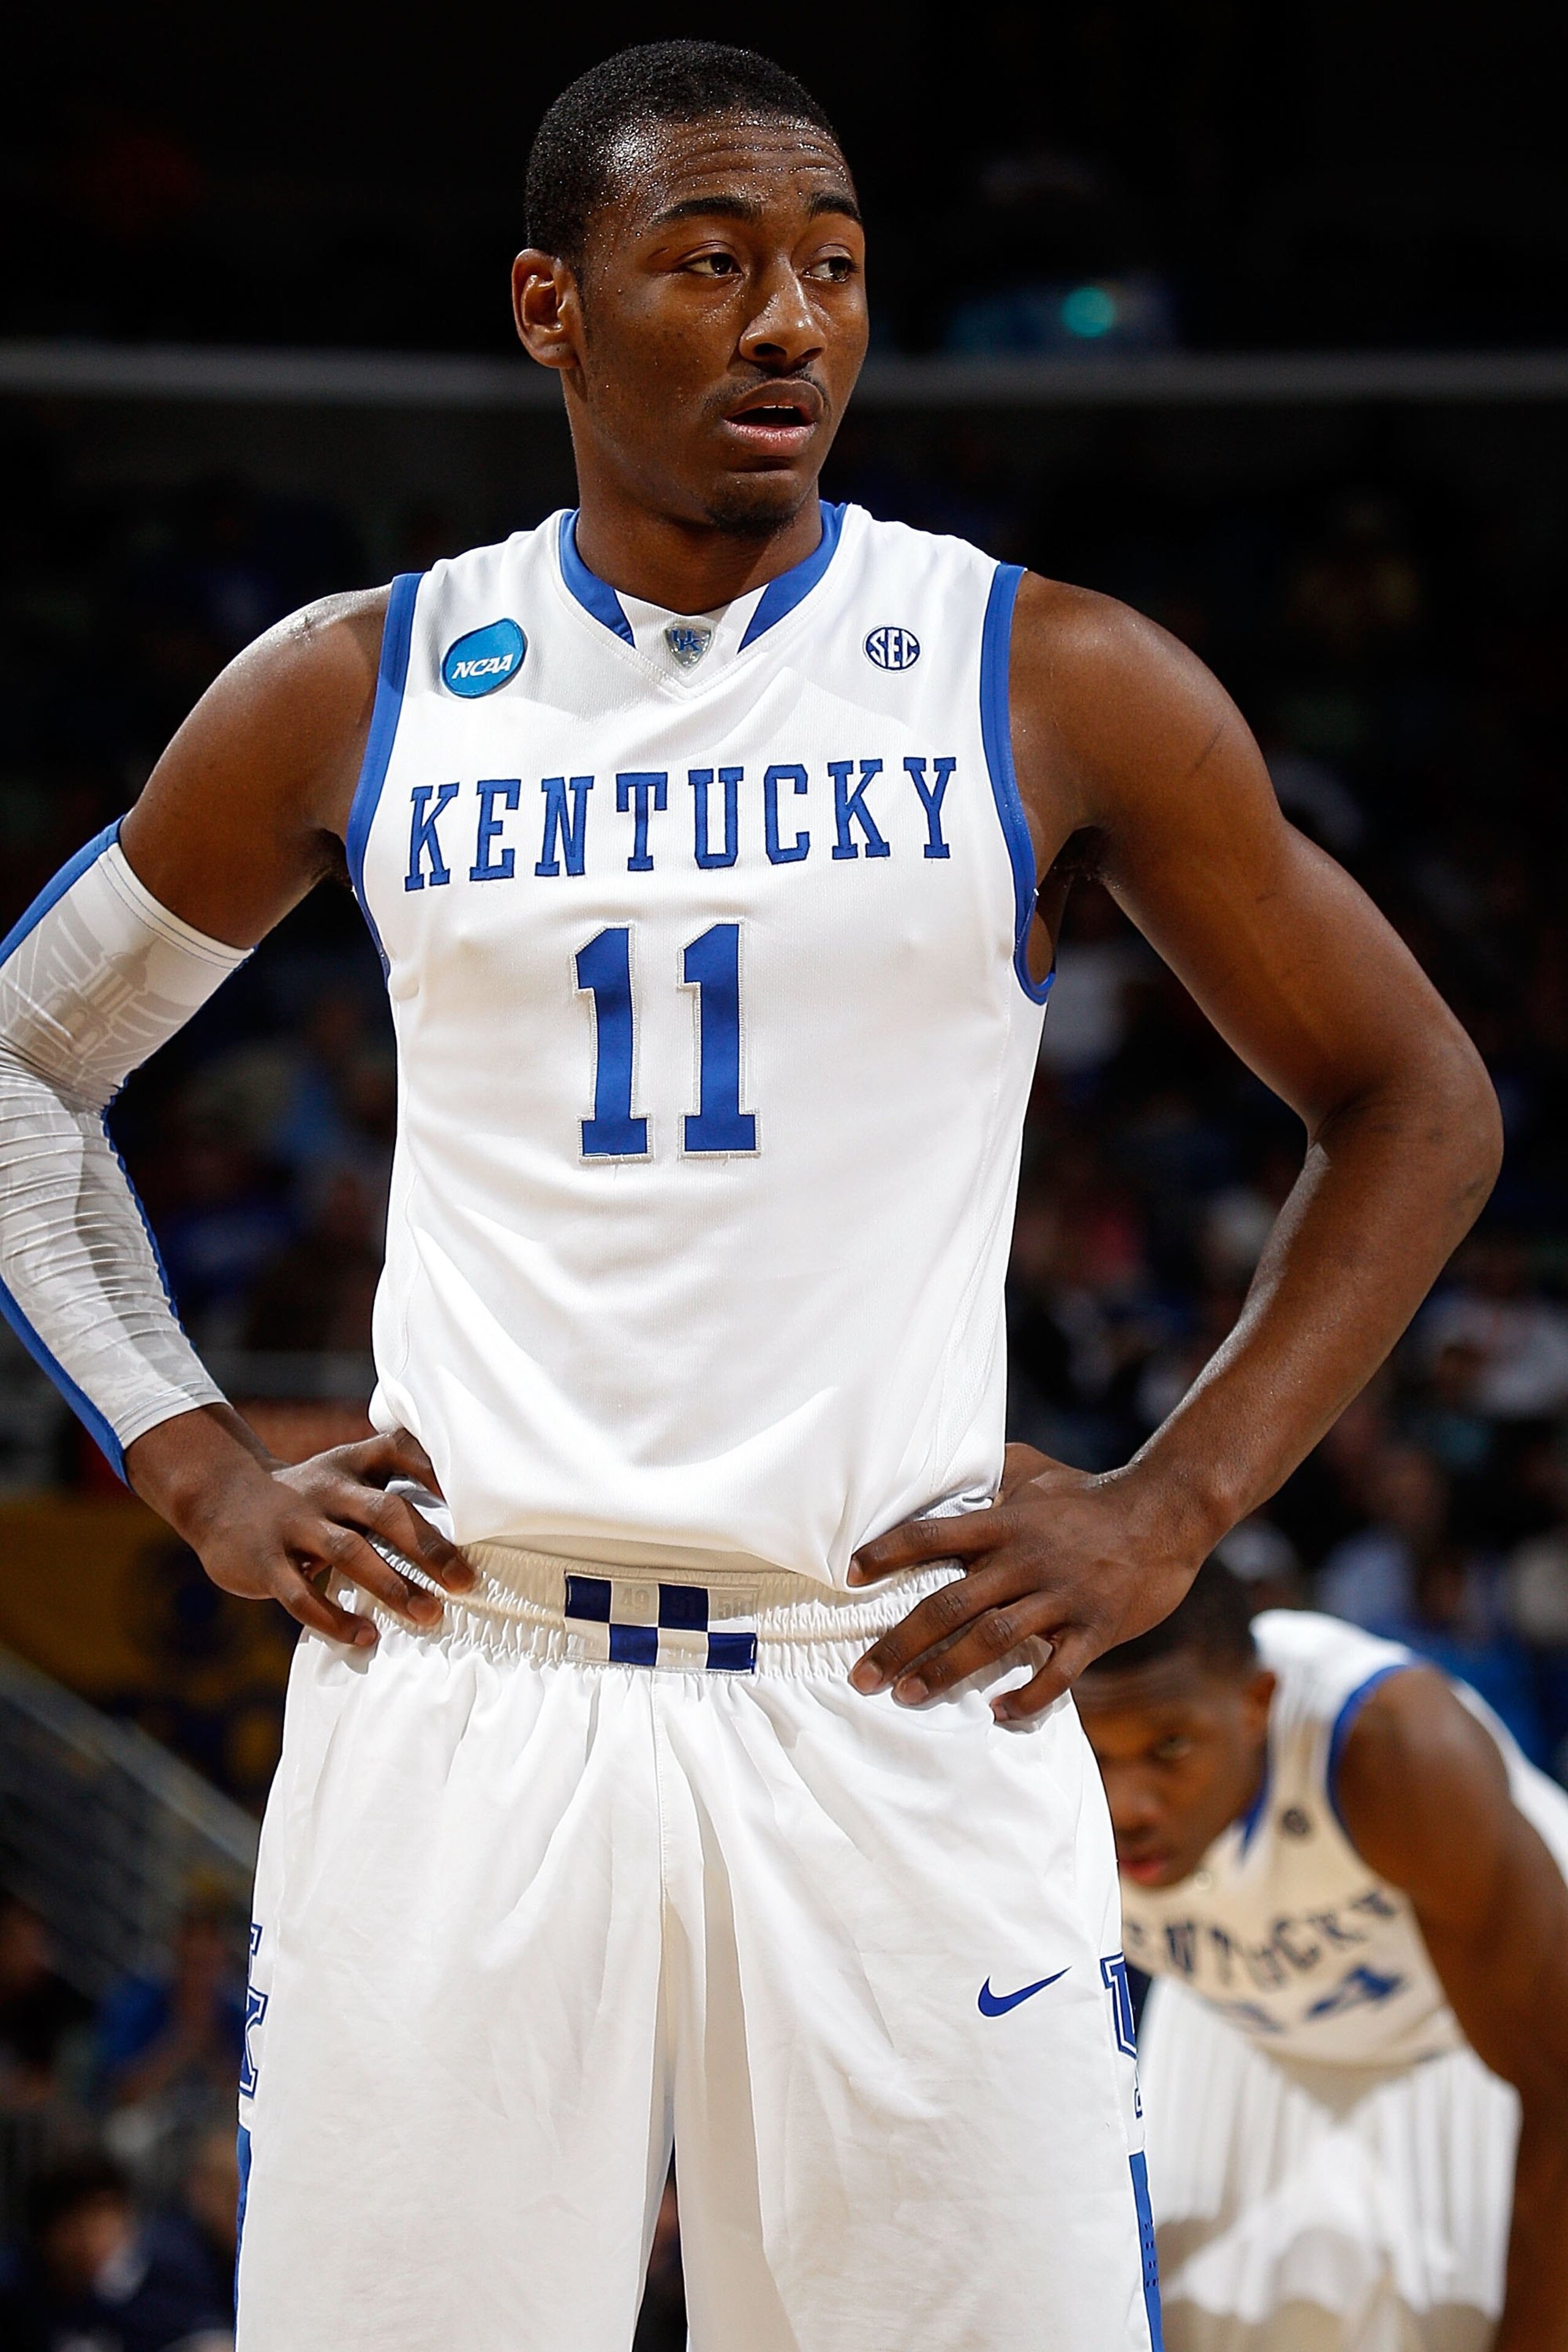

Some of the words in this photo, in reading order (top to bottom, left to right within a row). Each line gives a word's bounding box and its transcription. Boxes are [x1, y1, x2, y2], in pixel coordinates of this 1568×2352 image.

[451, 653, 514, 679] NCAA
[869, 628, 918, 668] SEC
[404, 757, 956, 892] KENTUCKY
[574, 920, 761, 1163] 11
